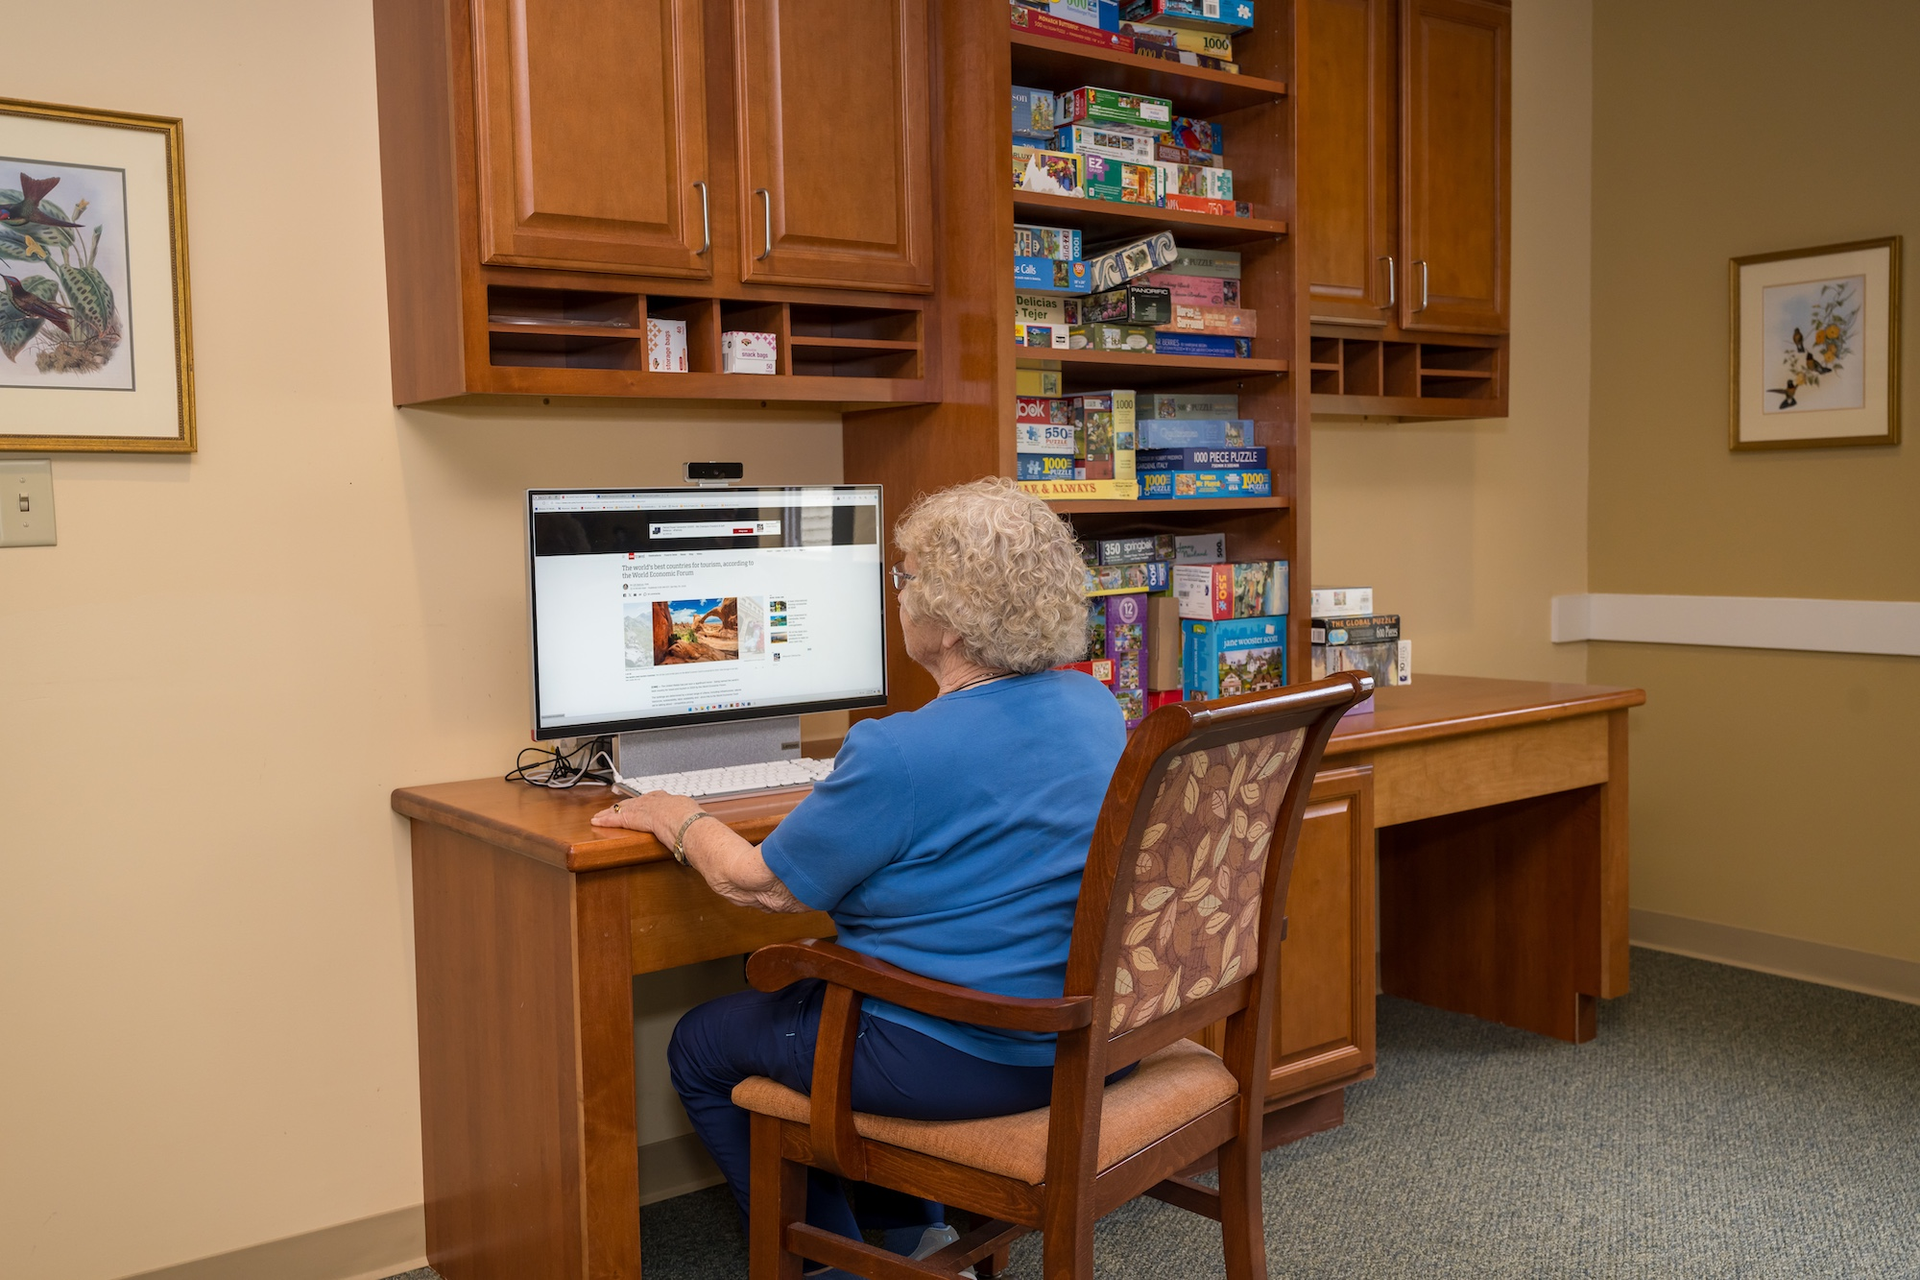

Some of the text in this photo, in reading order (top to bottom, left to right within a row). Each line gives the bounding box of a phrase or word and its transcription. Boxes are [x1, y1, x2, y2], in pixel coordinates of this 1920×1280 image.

[1204, 37, 1229, 50] 1000
[1088, 158, 1103, 169] EZ
[1020, 264, 1036, 274] Calls
[1131, 287, 1168, 295] PANORIFIC
[1016, 296, 1057, 308] Delicias
[1022, 308, 1048, 320] Tejer
[1116, 400, 1133, 409] 1000
[1045, 427, 1068, 439] 550
[1194, 452, 1257, 463] 1000 PIECE PUZZLE
[1042, 457, 1067, 474] 1000
[1144, 475, 1166, 490] 1000
[1241, 473, 1264, 488] 1000
[1041, 483, 1050, 494] &
[1052, 483, 1097, 493] ALWAYS
[1105, 540, 1153, 556] 350 springbok
[1219, 574, 1227, 600] 550
[1124, 603, 1133, 614] 12
[1372, 617, 1396, 626] PUZZLE
[1223, 635, 1278, 649] jane wooster scott
